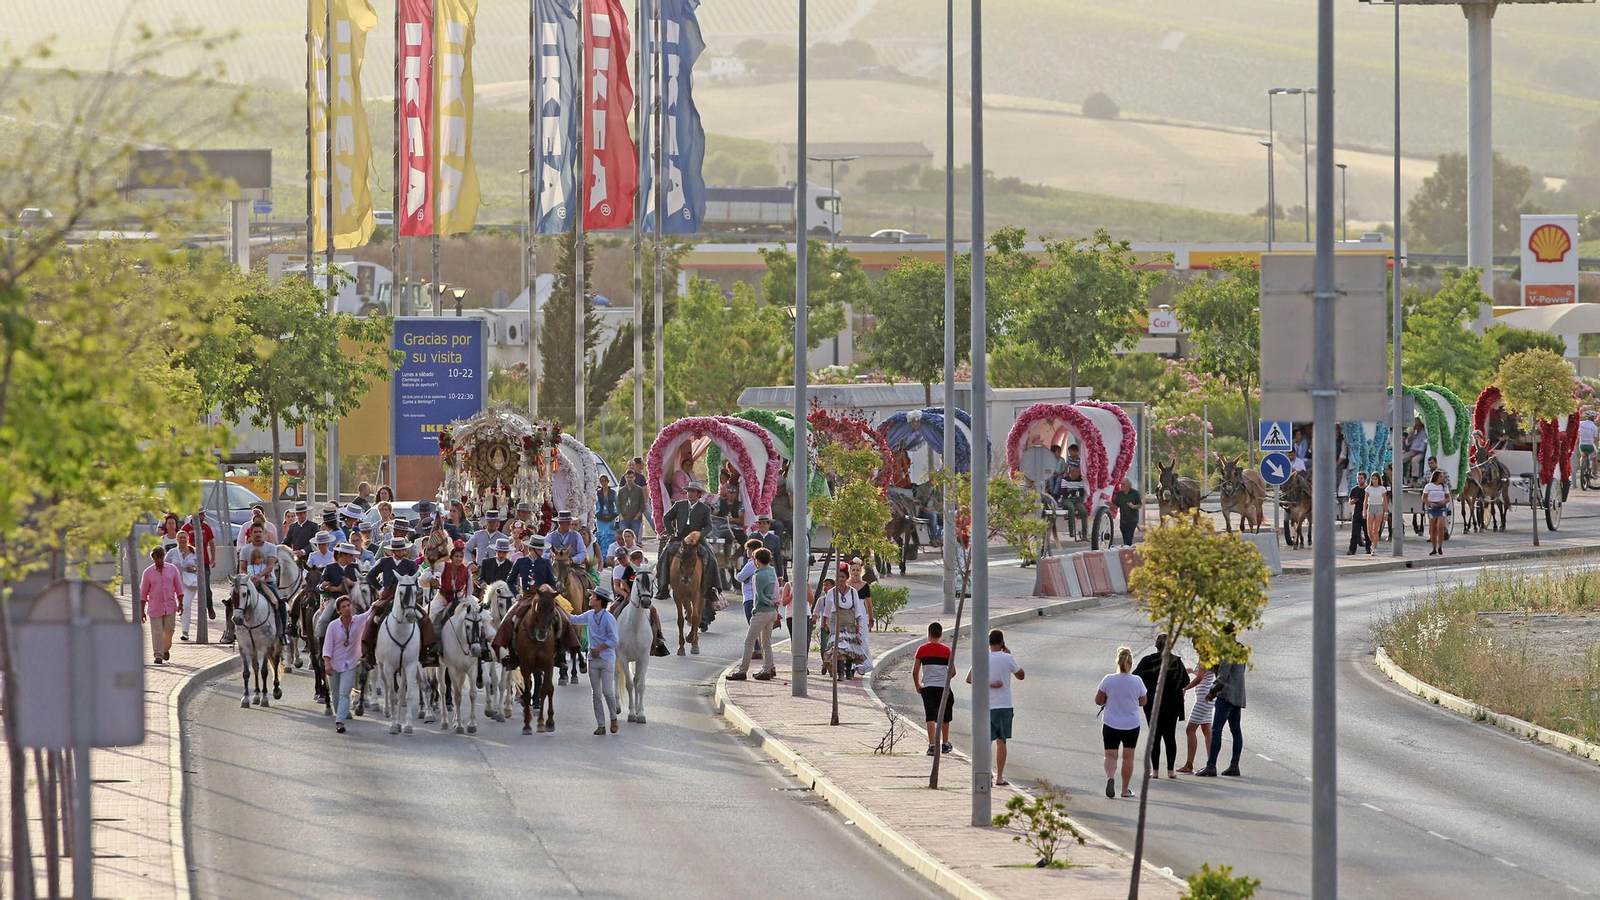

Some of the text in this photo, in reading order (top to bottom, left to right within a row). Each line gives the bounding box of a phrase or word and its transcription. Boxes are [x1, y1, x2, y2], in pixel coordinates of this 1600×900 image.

[335, 20, 355, 217] IKEA
[404, 22, 425, 218] IKEA
[438, 19, 466, 217] IKEA
[540, 22, 565, 217] IKEA
[588, 13, 611, 212] IKEA
[666, 19, 686, 217] IKEA
[403, 332, 472, 347] Gracias por
[412, 350, 462, 364] su visita
[448, 368, 473, 378] 10-22
[1153, 318, 1171, 328] Car
[1529, 296, 1571, 304] V-Power
